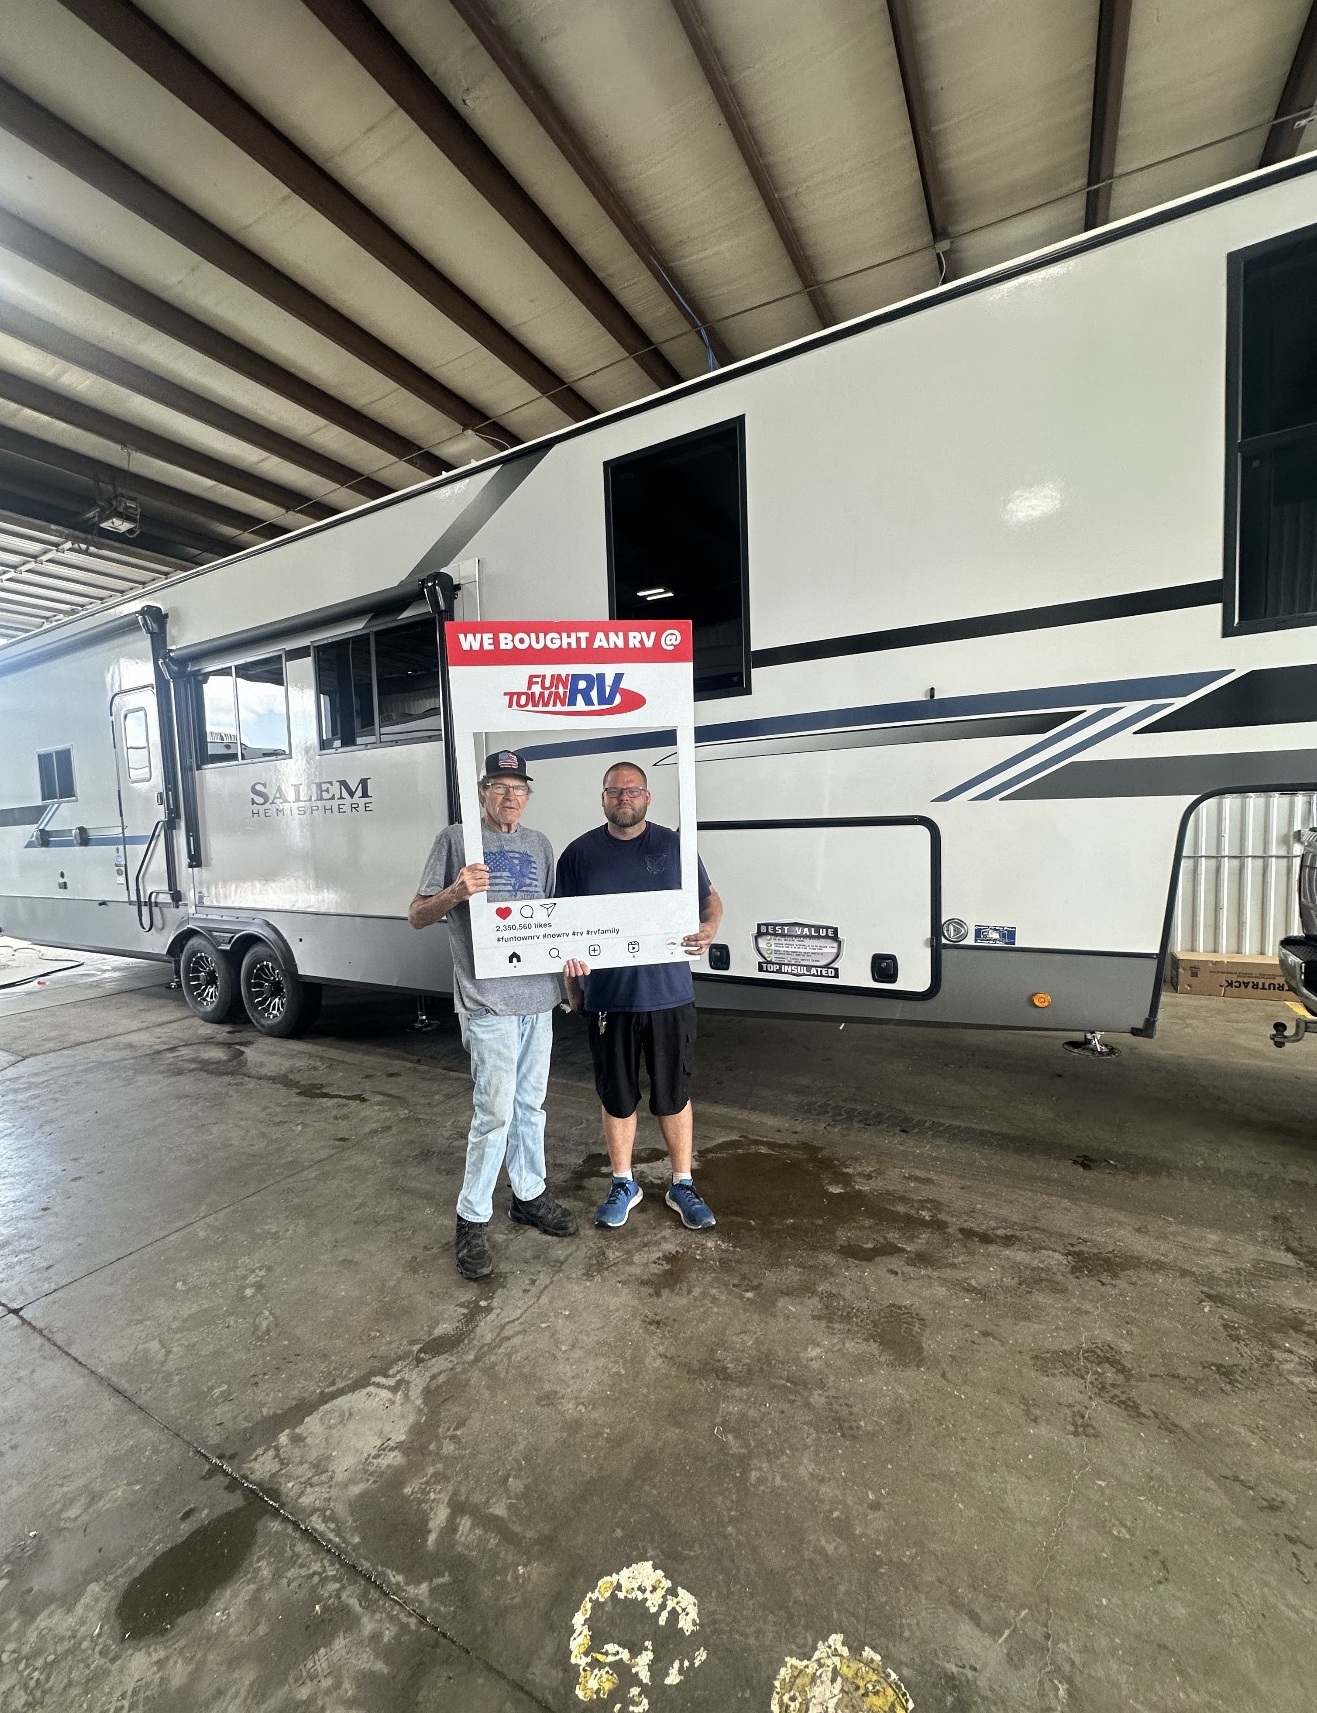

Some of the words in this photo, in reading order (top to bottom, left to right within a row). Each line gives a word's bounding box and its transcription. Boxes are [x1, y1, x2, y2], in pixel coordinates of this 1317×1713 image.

[458, 633, 495, 650] WE
[499, 632, 590, 650] BOUGHT
[593, 632, 624, 648] AN
[628, 631, 656, 648] RV
[660, 629, 681, 650] @
[527, 673, 570, 690] FUN
[567, 673, 625, 706] RV
[503, 691, 568, 708] TOWN
[250, 777, 373, 806] SALEM
[251, 802, 373, 818] HEMISPHERE
[496, 934, 540, 943] #funtownrv
[585, 927, 620, 936] #rvfamily
[760, 925, 790, 934] BEST
[795, 926, 835, 937] VALUE
[761, 963, 780, 972] TOP
[781, 964, 836, 977] INSULATED
